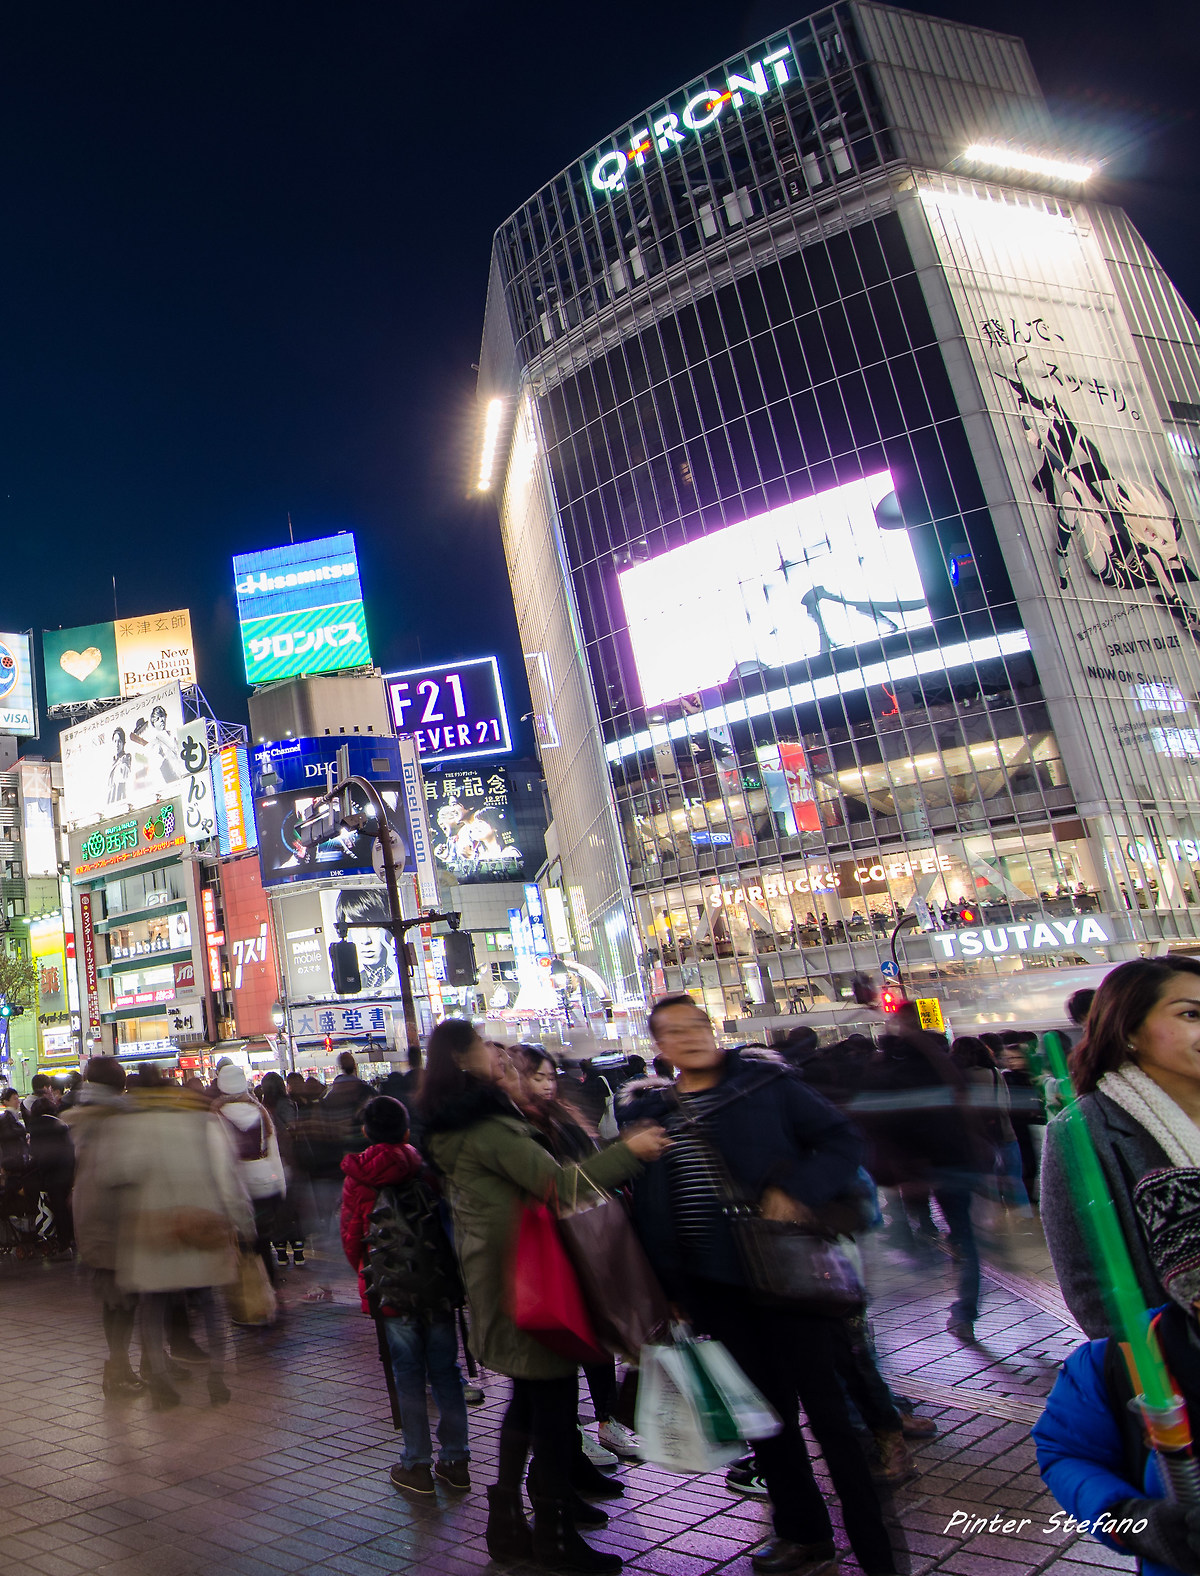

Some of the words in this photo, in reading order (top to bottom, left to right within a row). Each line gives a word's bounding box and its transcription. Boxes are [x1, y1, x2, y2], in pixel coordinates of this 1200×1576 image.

[592, 45, 791, 192] QFRONT
[980, 317, 1065, 348] 飛んで、
[1041, 360, 1141, 422] スッキリ。
[236, 561, 356, 595] Hisamitsu
[119, 614, 187, 638] 米津玄師
[161, 648, 189, 660] New
[249, 621, 362, 662] サロンパス
[124, 666, 191, 684] Bremen
[147, 658, 190, 671] Album
[3, 713, 29, 724] VISA
[416, 724, 472, 752] EVER
[180, 734, 214, 835] もんじゃ
[403, 757, 421, 813] Taisei
[106, 828, 138, 854] 西村
[411, 817, 427, 863] neon
[1166, 838, 1200, 862] TS
[330, 869, 344, 877] DHC
[710, 871, 841, 909] STARBUCKS
[853, 854, 952, 885] COFFEE
[292, 939, 320, 954] DMM
[935, 916, 1109, 958] TSUTAYA
[293, 952, 322, 965] mobile
[297, 964, 322, 974] のスマホ
[40, 965, 61, 994] 薬
[176, 964, 194, 984] JTB
[298, 1007, 386, 1035] 大盛堂書
